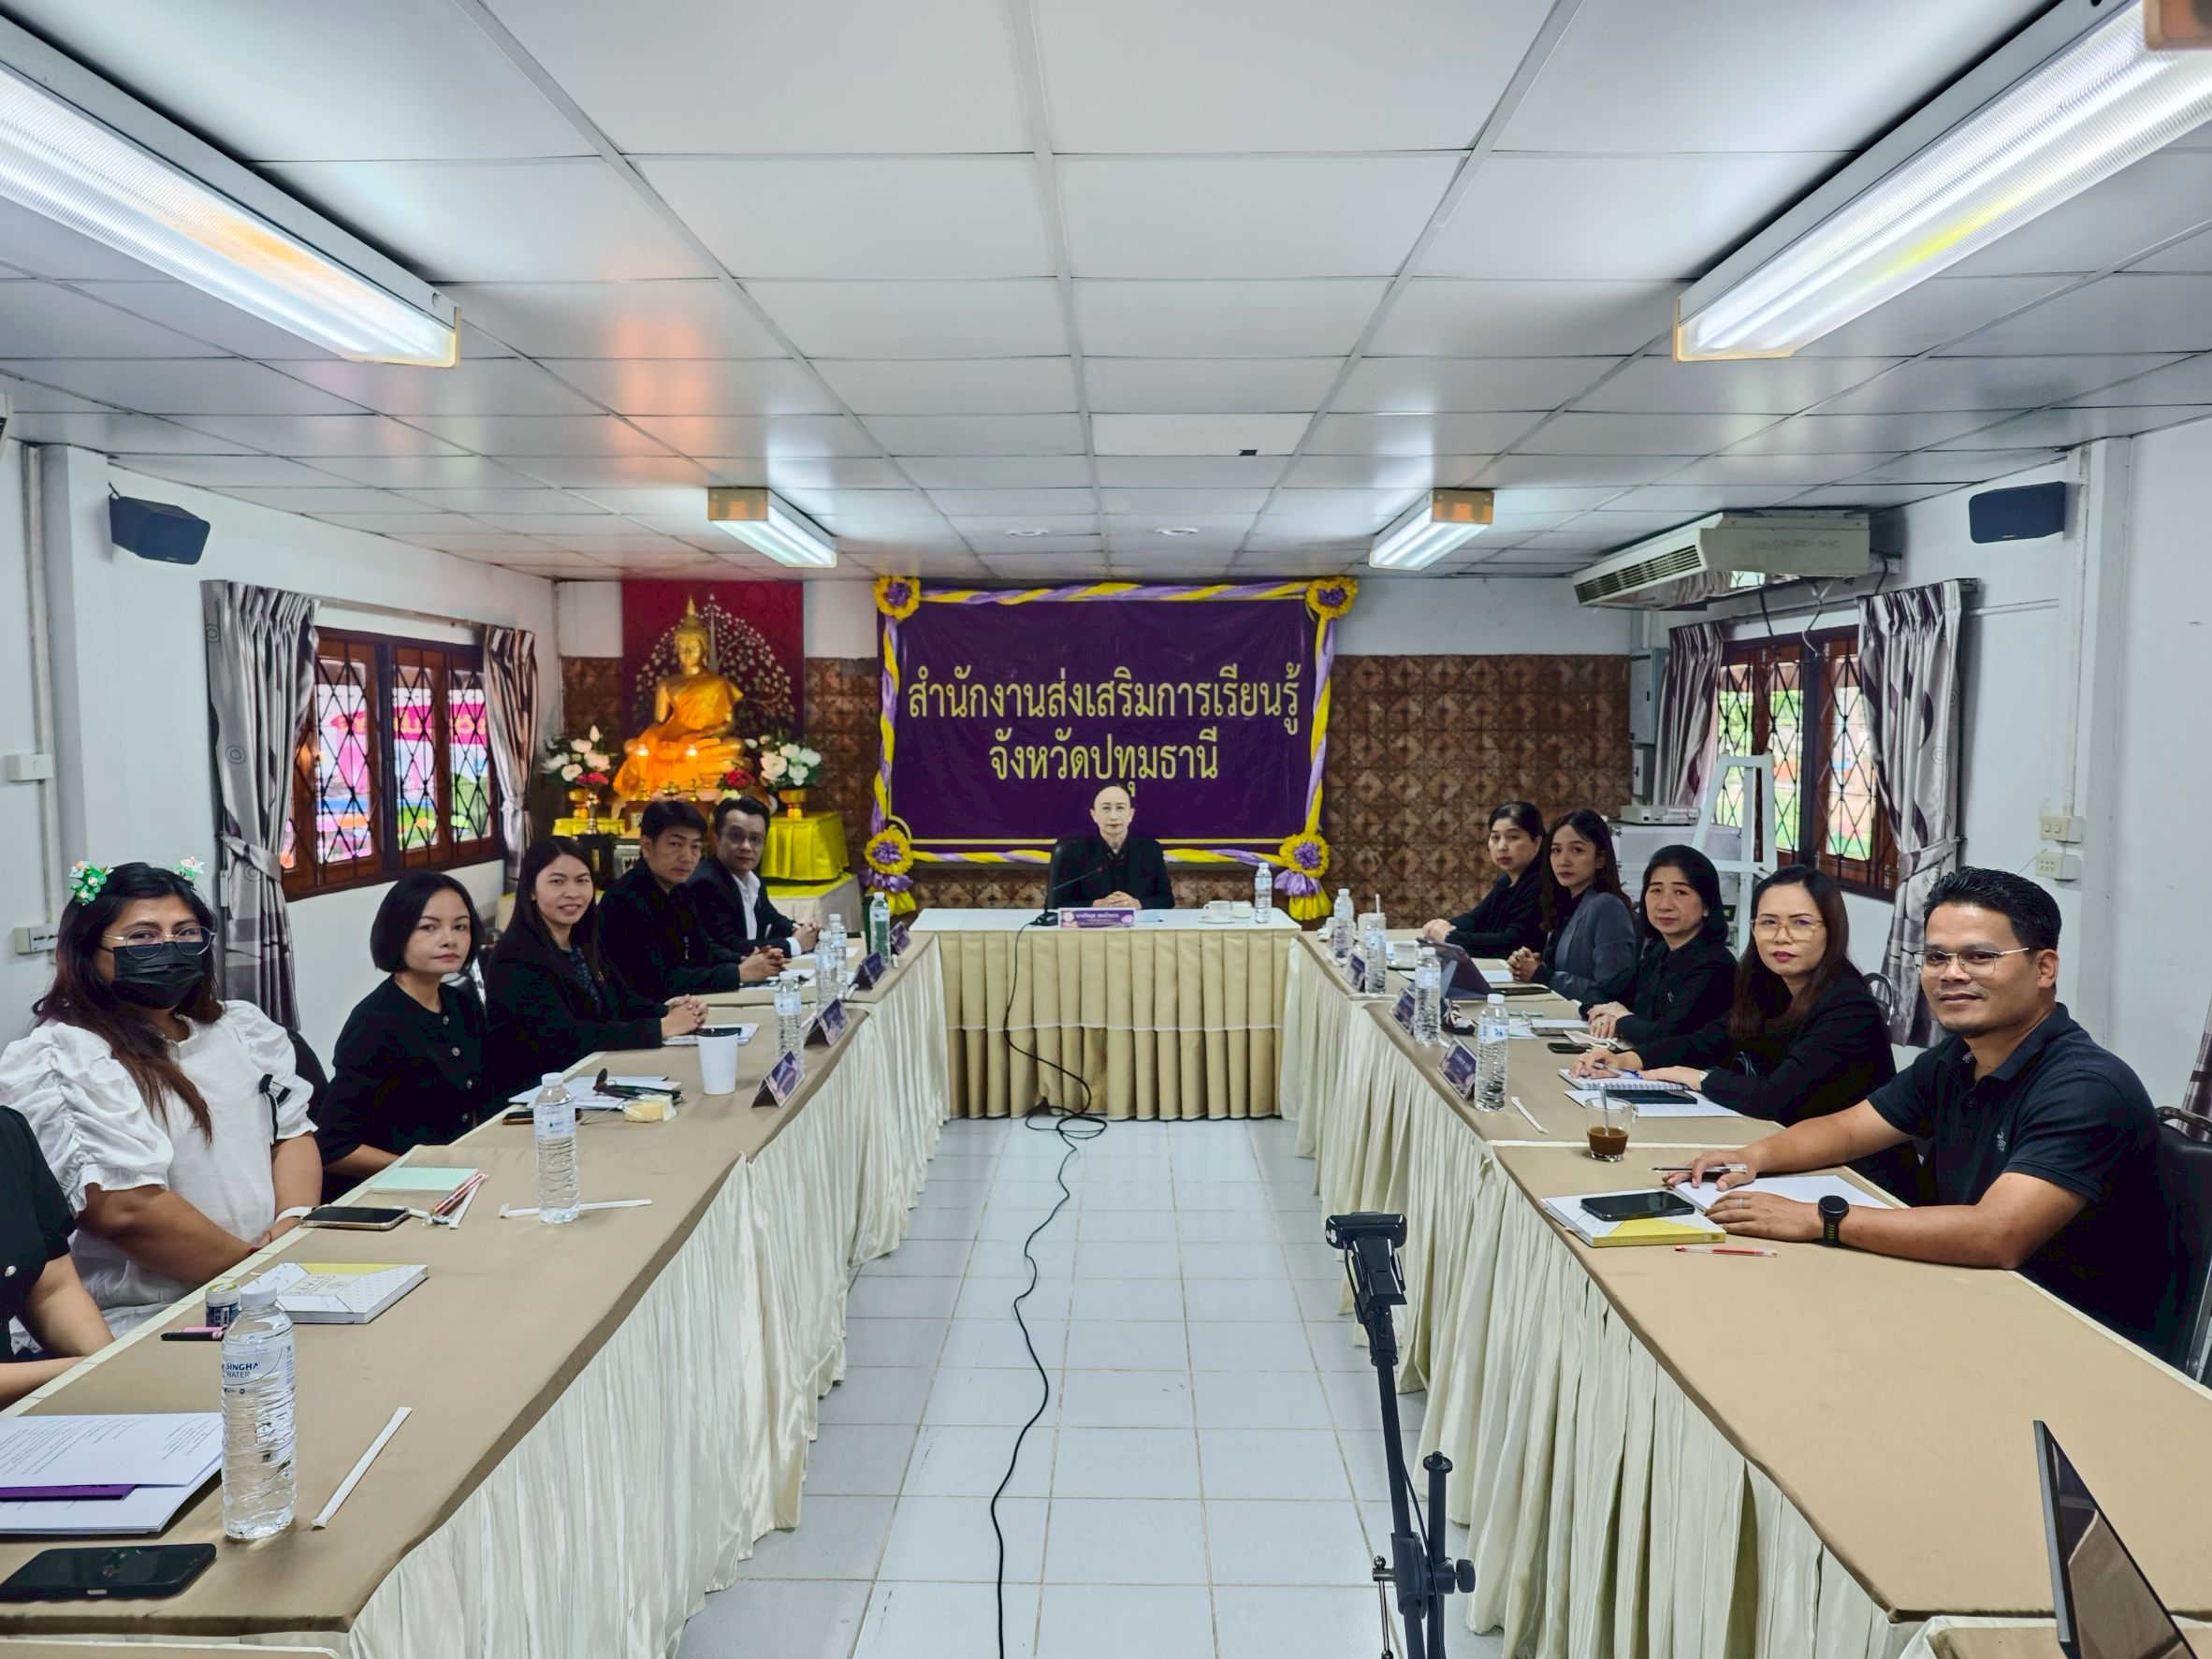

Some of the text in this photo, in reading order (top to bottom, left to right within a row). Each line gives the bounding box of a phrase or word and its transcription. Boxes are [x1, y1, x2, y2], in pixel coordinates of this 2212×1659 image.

[908, 661, 1301, 735] สำนักงานส่งเสริมการเรียนรู้
[989, 725, 1218, 797] จังหวัดปทุมธานี
[225, 1362, 259, 1371] SINGHA
